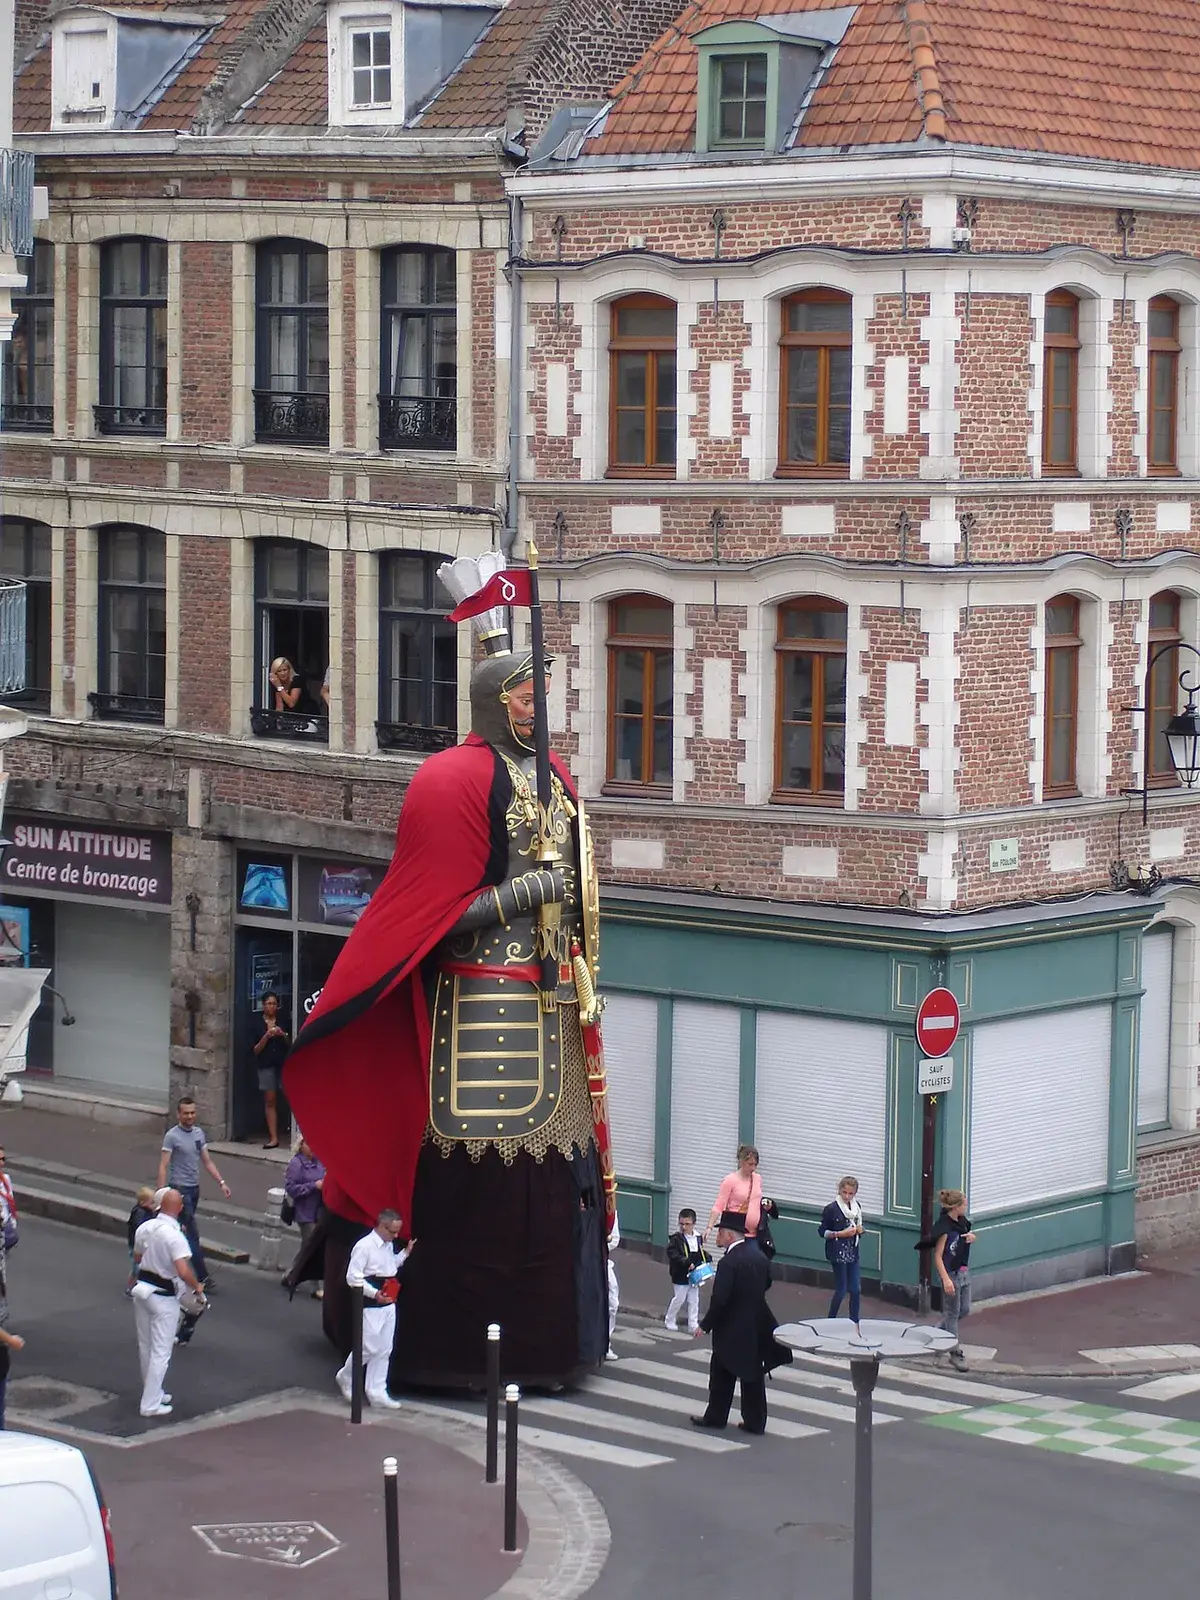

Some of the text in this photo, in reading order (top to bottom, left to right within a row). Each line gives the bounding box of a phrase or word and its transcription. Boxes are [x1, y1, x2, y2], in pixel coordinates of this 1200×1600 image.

[14, 825, 152, 861] SUN ATTITUDE
[6, 857, 158, 897] Centre de bronzage
[929, 1064, 944, 1074] SAUF
[921, 1076, 951, 1088] CYCLISTES
